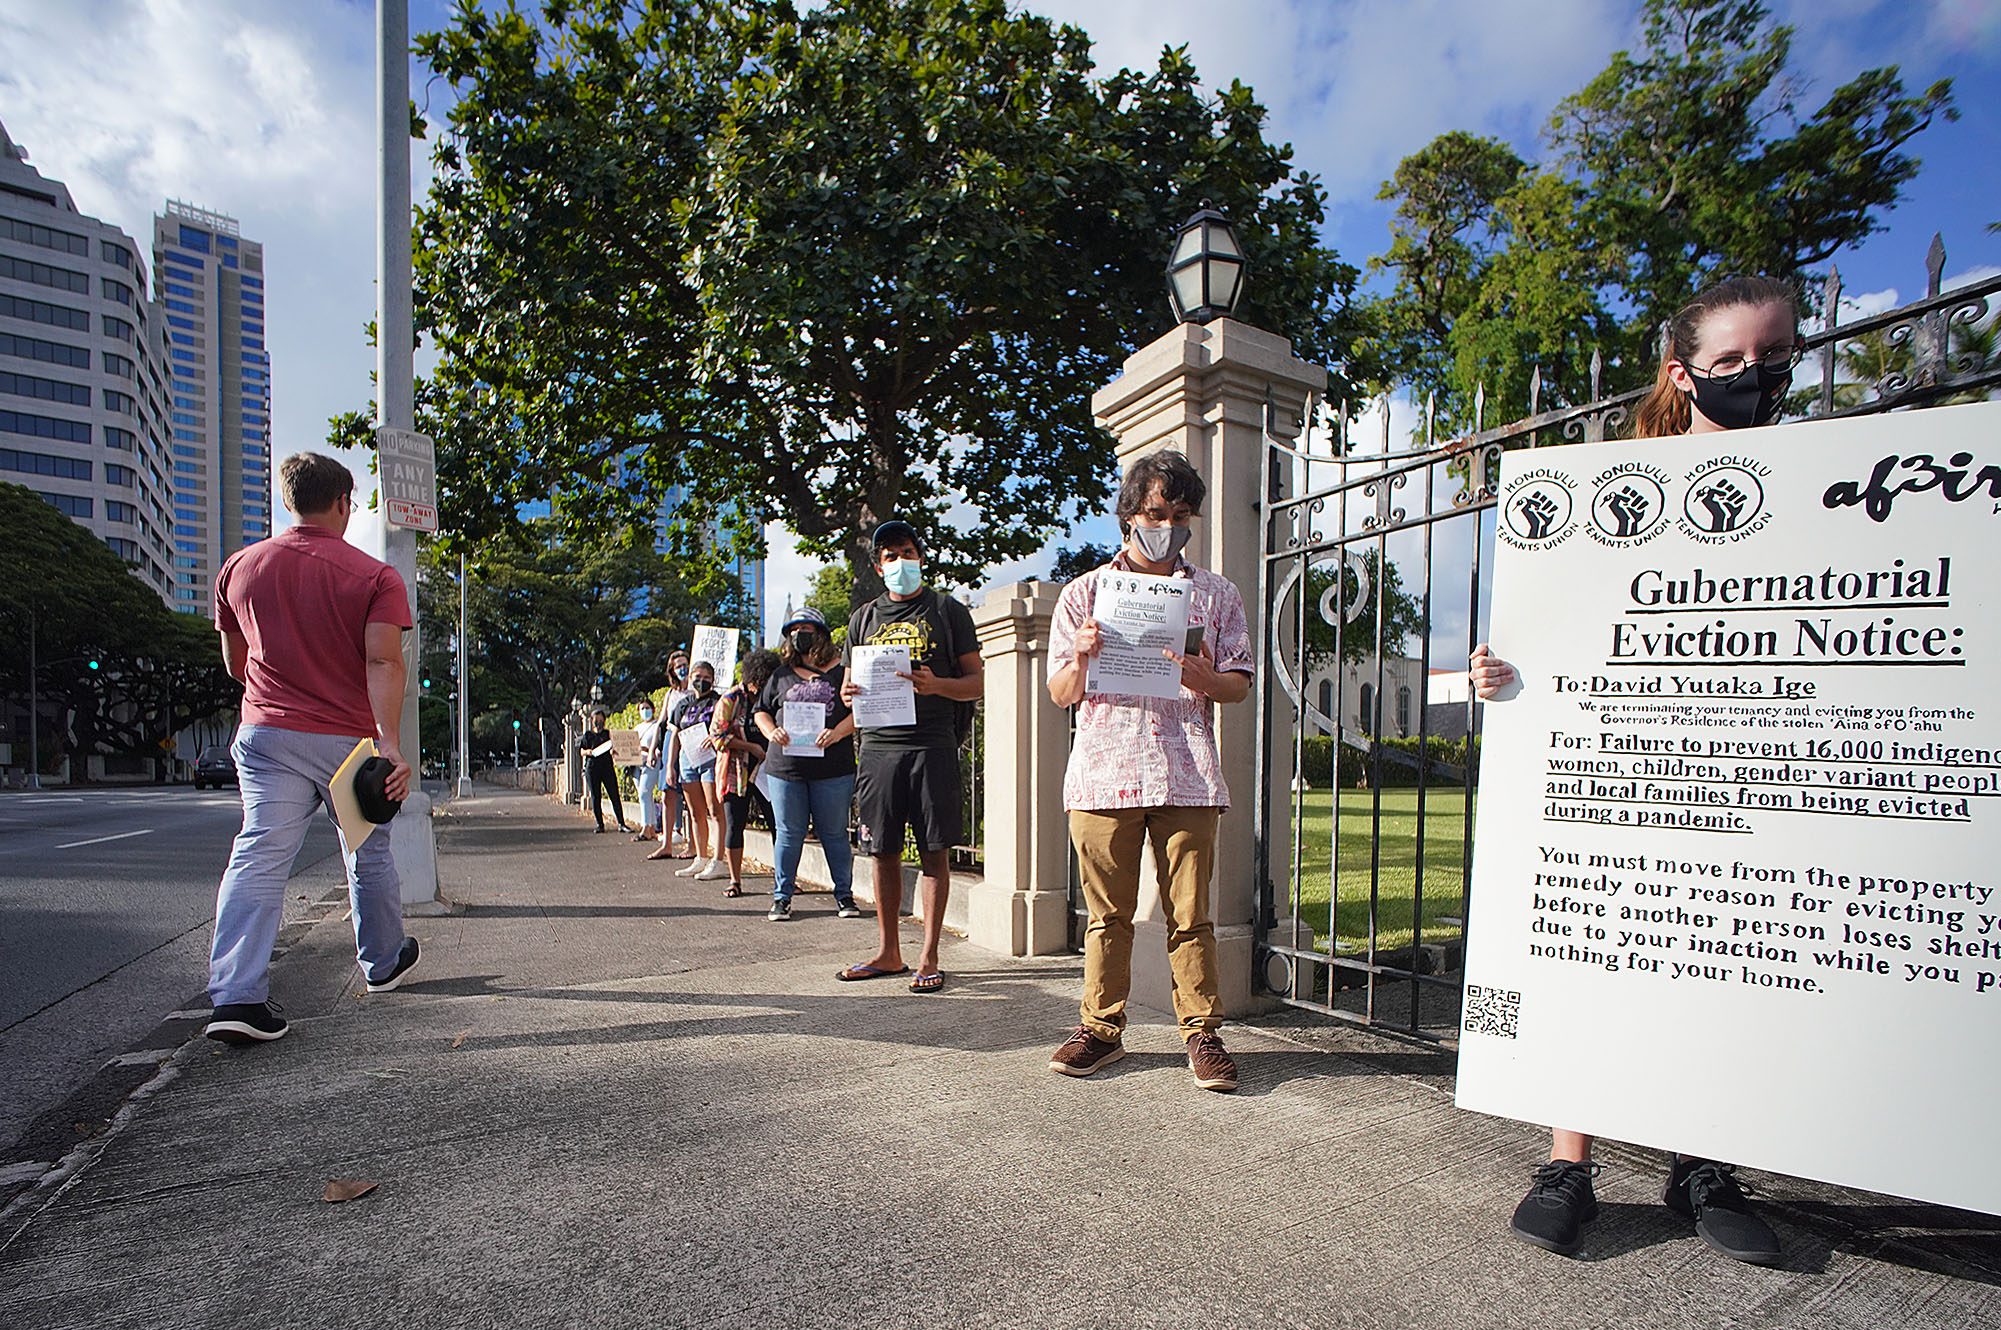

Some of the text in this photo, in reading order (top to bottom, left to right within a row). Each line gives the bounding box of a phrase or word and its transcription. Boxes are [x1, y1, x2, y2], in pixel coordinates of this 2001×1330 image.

[380, 432, 430, 457] NO PARKING
[393, 463, 424, 482] ANY
[1504, 468, 1578, 494] HONOLULU
[1591, 462, 1672, 489] HONOLULU
[1684, 455, 1773, 482] HONOLULU
[391, 481, 428, 503] TIME
[405, 514, 423, 525] ZONE
[1583, 518, 1672, 549] TENANTS UNION
[1674, 512, 1773, 546] TENANTS UNION
[1497, 522, 1580, 552] TENANTS UNION
[1629, 556, 1951, 606] Gubernatorial
[1610, 617, 1964, 658] Eviction Notice:
[1671, 676, 1763, 695] Yutaka
[1772, 676, 1816, 699] Ige
[1578, 701, 1975, 720] We are terminating your tenancy and evicting you from the
[1600, 713, 1667, 726] Governor's
[1671, 715, 1737, 727] Residence
[1741, 716, 1754, 727] of
[1757, 716, 1779, 728] the
[1782, 718, 1824, 729] stolen
[1874, 719, 1892, 730] of
[1549, 731, 1592, 749] For:
[1599, 733, 1675, 752] Failure
[1681, 736, 1702, 752] to
[1708, 739, 1798, 758] prevent
[1805, 740, 1883, 761] 16,000
[1548, 758, 1625, 777] women,
[1632, 758, 1726, 782] children,
[1734, 764, 1817, 783] gender
[1824, 768, 1916, 788] variant
[1546, 780, 1970, 817] and local families from being evicted
[1544, 802, 1752, 830] during a pandemic.
[1538, 846, 1994, 905] You must move from the property
[1535, 873, 1622, 896] remedy
[1634, 881, 1678, 897] our
[1688, 886, 1775, 907] reason
[1790, 892, 1832, 913] for
[1846, 900, 1965, 933] evicting
[1533, 893, 1606, 917] before
[1620, 906, 1718, 929] another
[1732, 917, 1825, 940] person
[1843, 923, 1912, 951] loses
[1529, 943, 1824, 994] nothing for your home.
[1531, 917, 2001, 993] due to your inaction while you p
